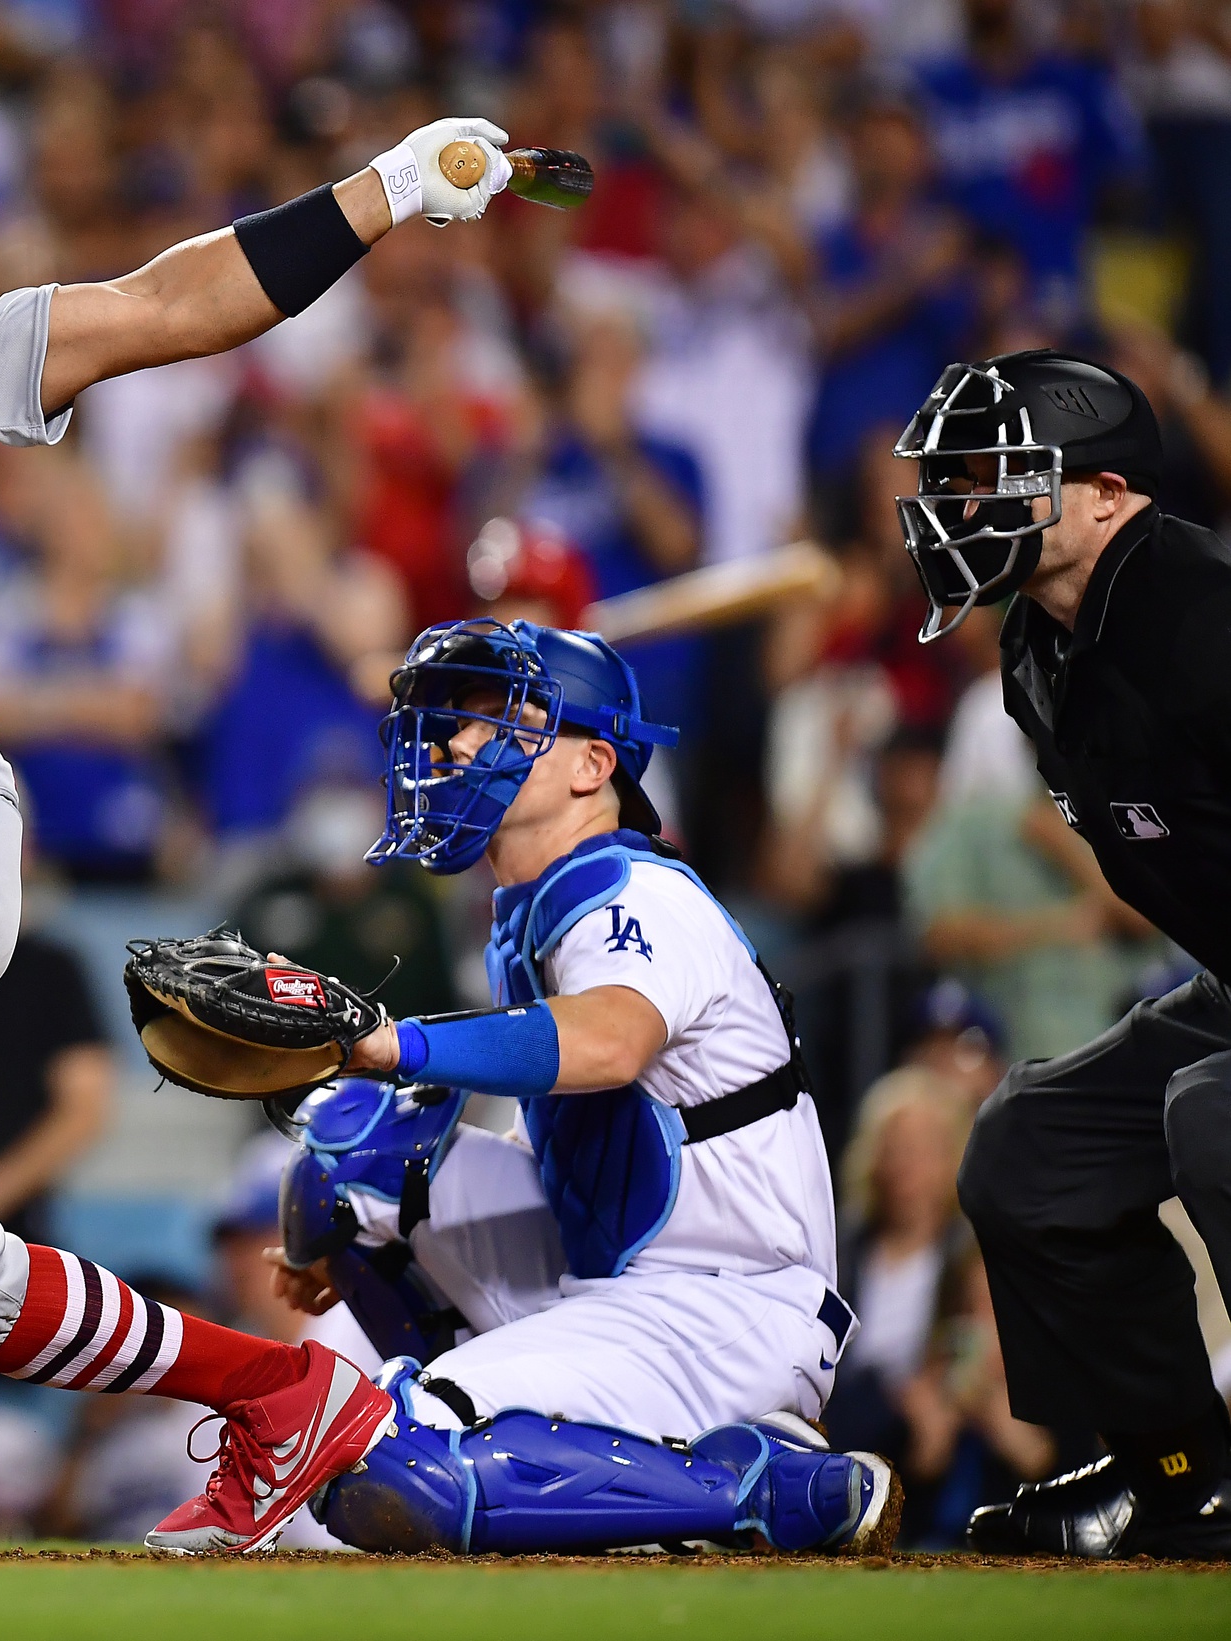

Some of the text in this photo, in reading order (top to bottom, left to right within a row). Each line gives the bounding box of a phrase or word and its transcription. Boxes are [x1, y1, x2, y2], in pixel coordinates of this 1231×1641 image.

[388, 164, 419, 195] 5
[604, 904, 653, 963] LA
[273, 979, 317, 995] Rawlings
